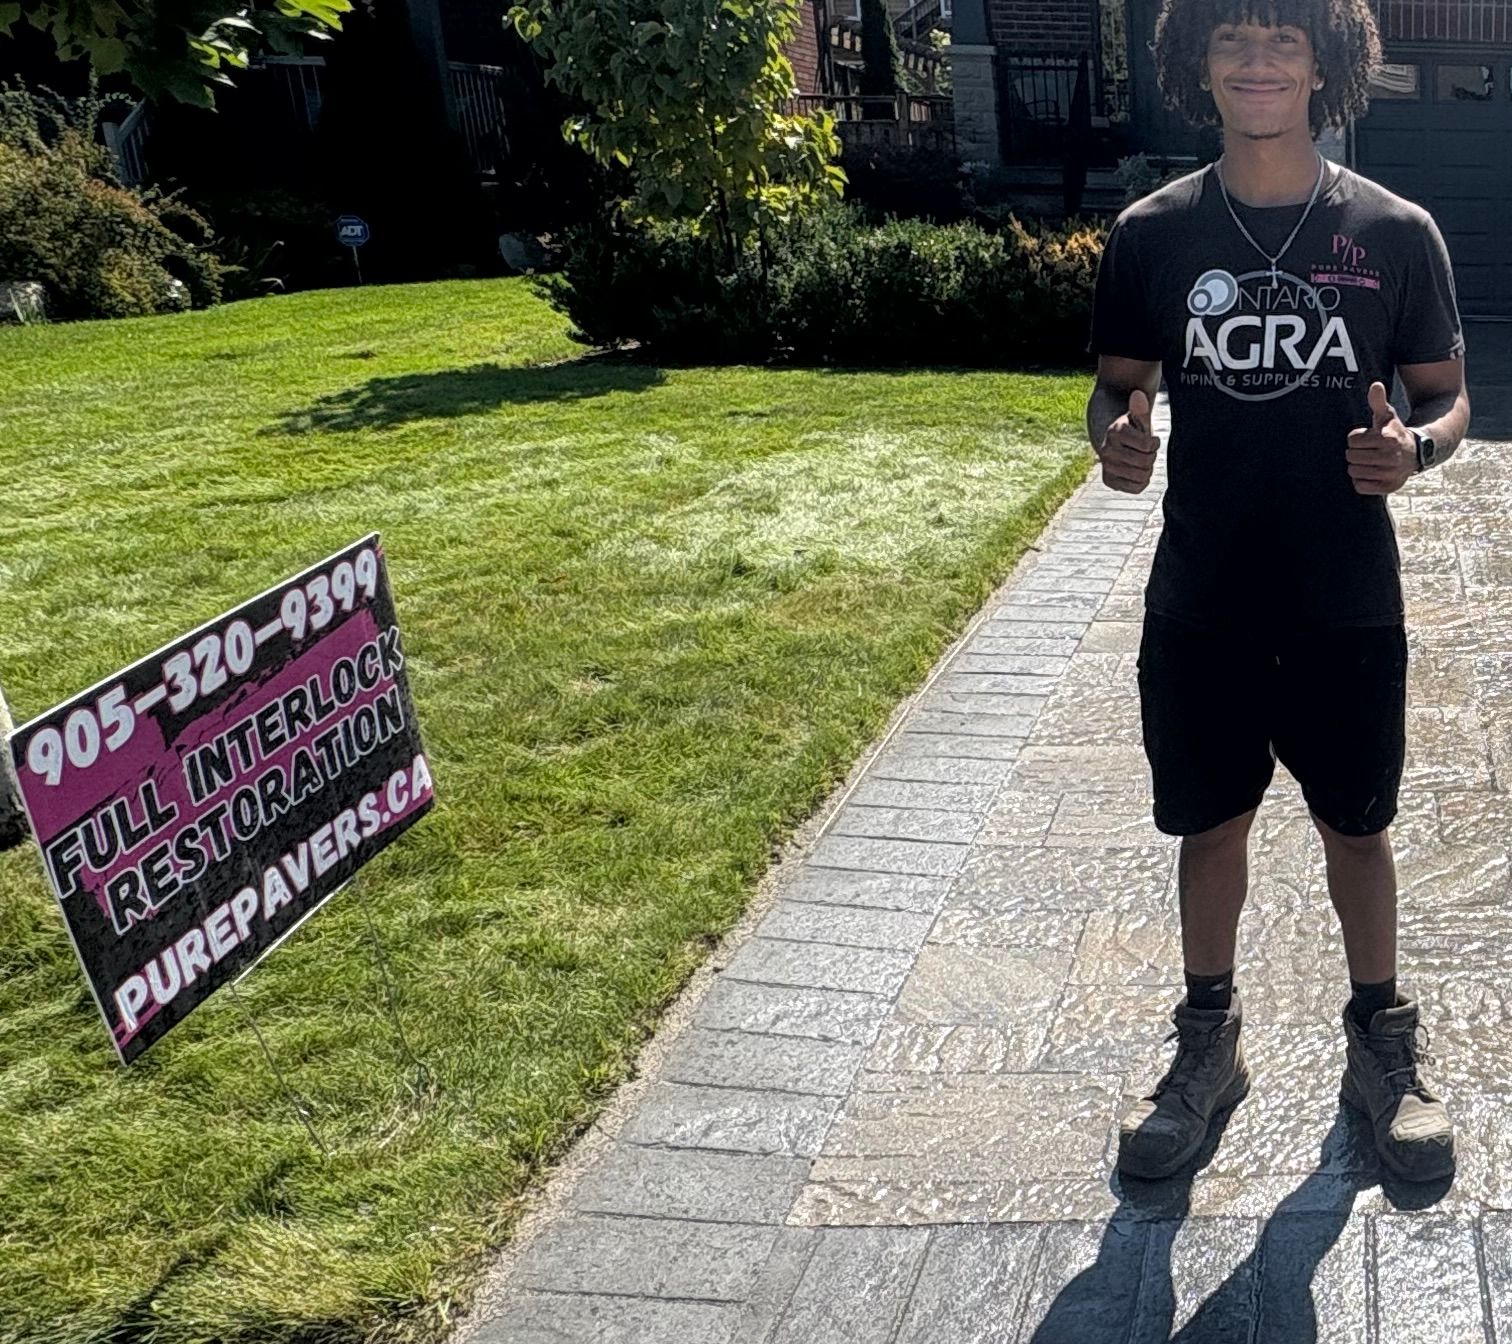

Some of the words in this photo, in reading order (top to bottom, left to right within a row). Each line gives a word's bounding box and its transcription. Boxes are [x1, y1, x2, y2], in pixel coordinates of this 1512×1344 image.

[340, 225, 363, 237] ADT
[1182, 315, 1359, 372] AGRA
[1226, 373, 1237, 386] &
[1241, 372, 1321, 388] SUPPLIES
[1325, 375, 1356, 389] INC
[27, 549, 378, 785] 905-320-9399
[46, 780, 176, 900] FULL
[181, 625, 404, 807] INTERLOCK
[103, 684, 404, 936] RESTORATION
[113, 753, 433, 1032] PUREPAVERS.CA
